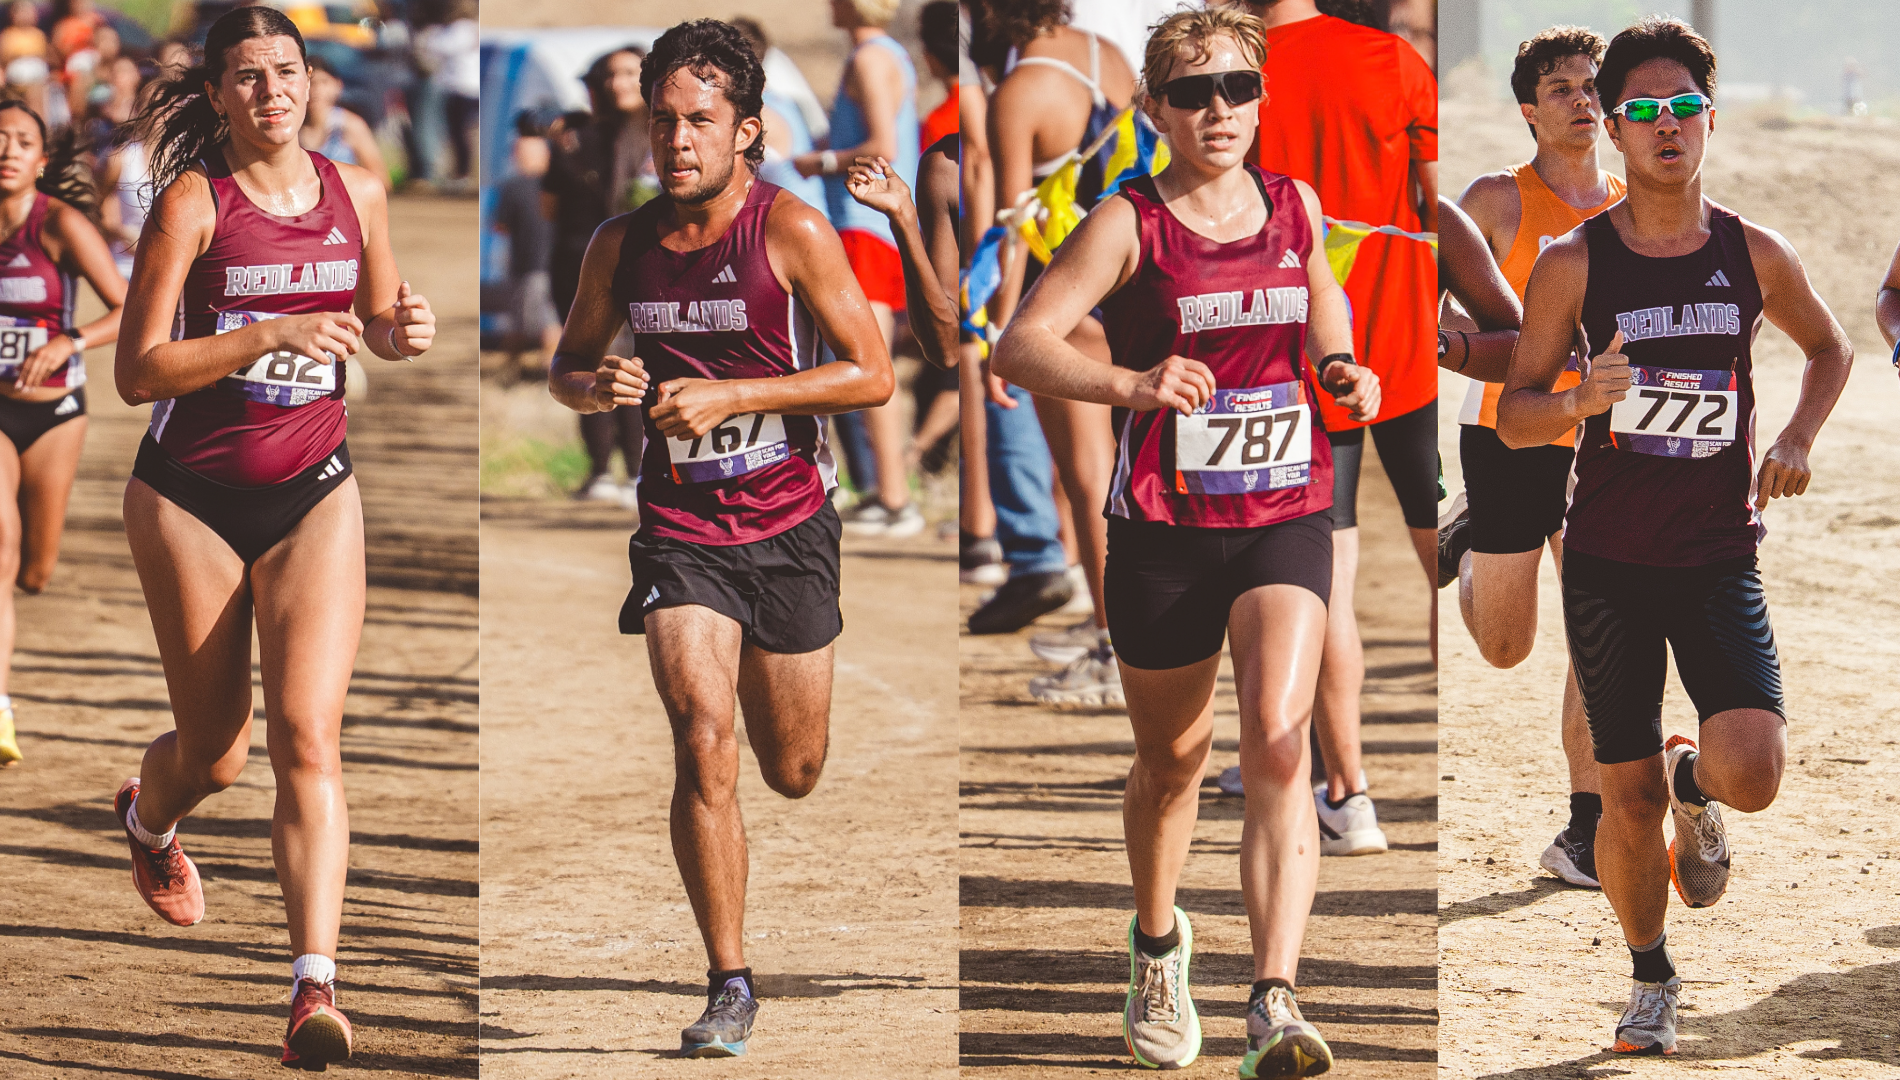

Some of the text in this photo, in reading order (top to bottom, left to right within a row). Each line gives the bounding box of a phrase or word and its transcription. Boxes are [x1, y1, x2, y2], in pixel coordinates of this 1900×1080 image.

[224, 259, 358, 296] REDLANDS
[629, 299, 749, 333] REDLANDS
[1177, 286, 1309, 335] REDLANDS
[1616, 302, 1741, 344] REDLANDS
[235, 351, 323, 385] 82
[1663, 380, 1701, 390] RESULTS
[1666, 371, 1703, 381] FINISHED
[1234, 400, 1273, 412] RESULTS
[1236, 390, 1273, 402] FINISHED
[1635, 389, 1729, 436] 772
[1205, 410, 1301, 467] 787
